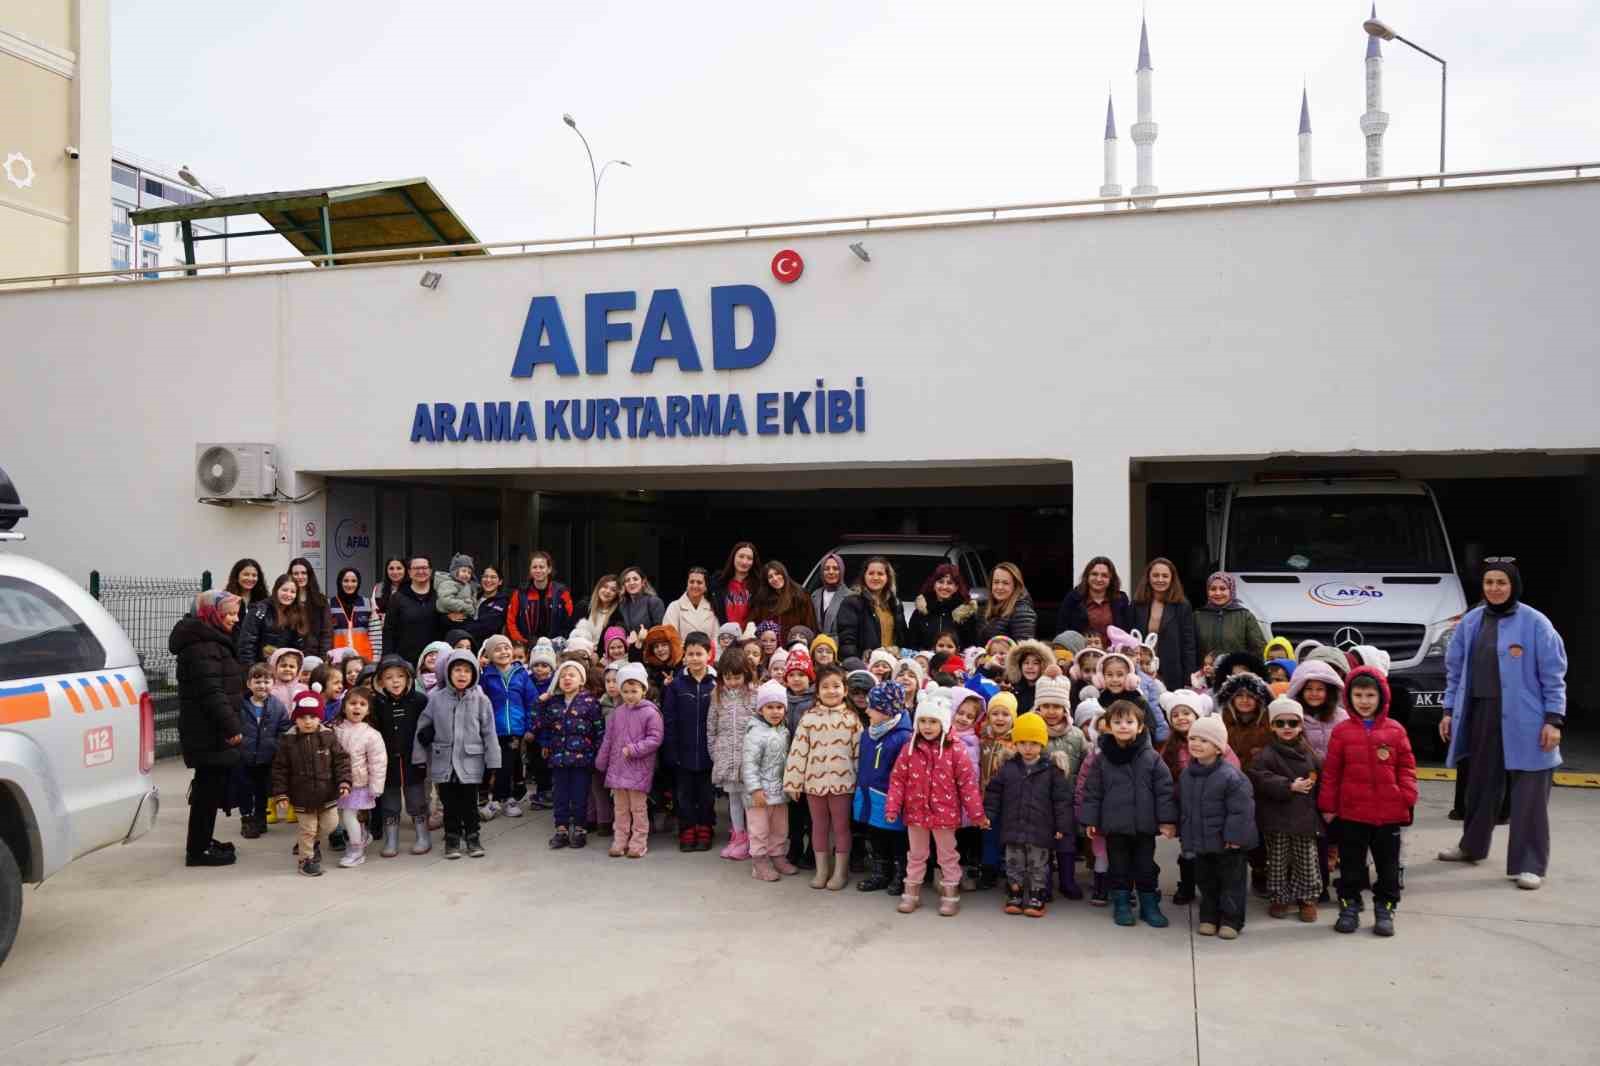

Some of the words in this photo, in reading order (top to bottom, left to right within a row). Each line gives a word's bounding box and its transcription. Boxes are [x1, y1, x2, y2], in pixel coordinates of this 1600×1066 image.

[511, 284, 777, 378] AFAD
[410, 400, 537, 442] ARAMA
[544, 393, 748, 441] KURTARMA
[756, 376, 866, 435] EKİBİ
[345, 535, 369, 549] AFAD
[1337, 589, 1383, 598] AFAD
[1416, 693, 1433, 705] AK
[88, 730, 109, 752] 112
